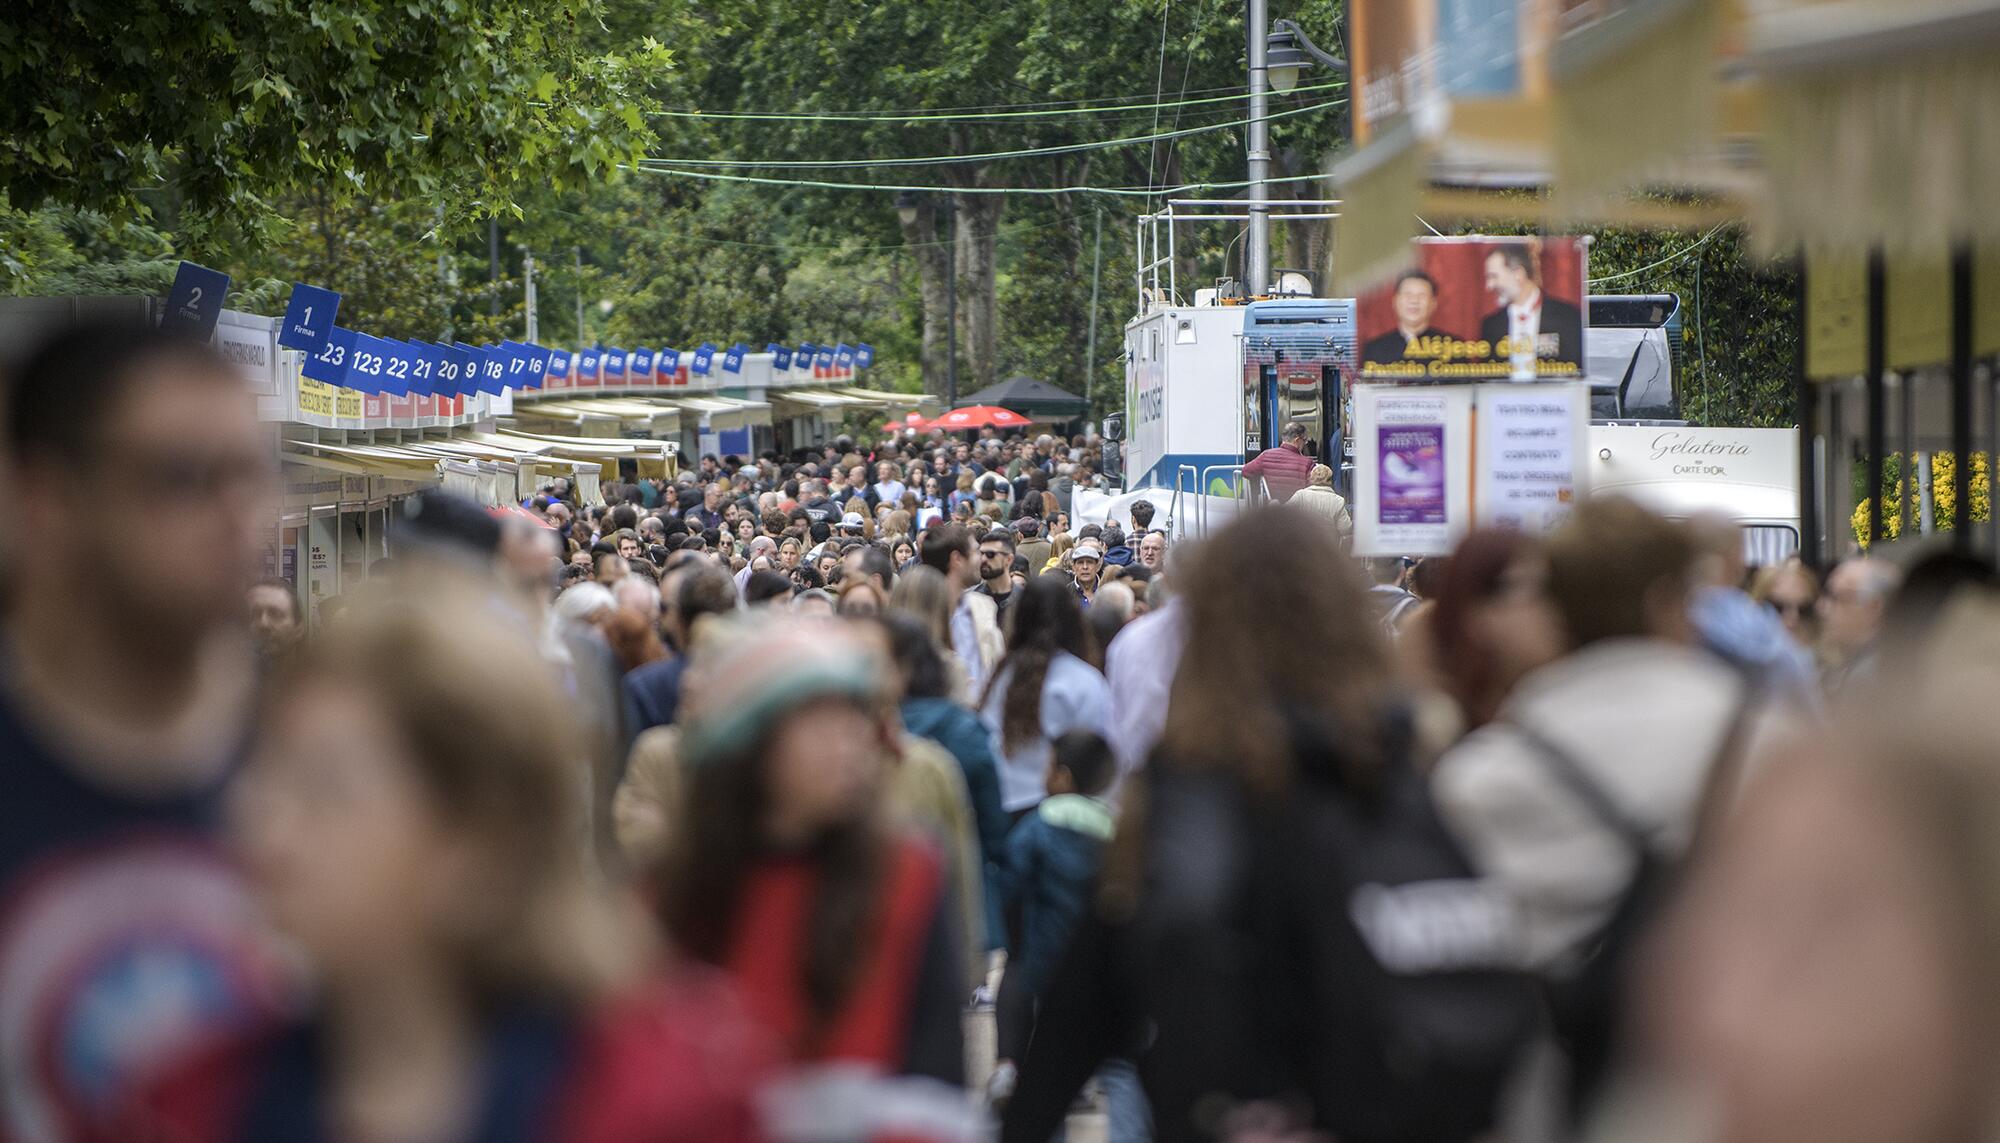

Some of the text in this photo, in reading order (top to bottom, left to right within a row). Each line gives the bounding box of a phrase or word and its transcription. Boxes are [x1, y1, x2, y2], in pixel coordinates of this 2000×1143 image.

[186, 286, 202, 310] 2
[179, 306, 201, 320] Firmas
[304, 306, 313, 327] 1
[294, 324, 316, 338] Firmas
[314, 342, 346, 366] 23
[1403, 335, 1491, 362] Aléjese
[352, 350, 382, 376] 123
[1362, 358, 1578, 378] Partido Comunist hino
[1650, 431, 1753, 461] Gelateria
[1673, 464, 1701, 475] CARTE
